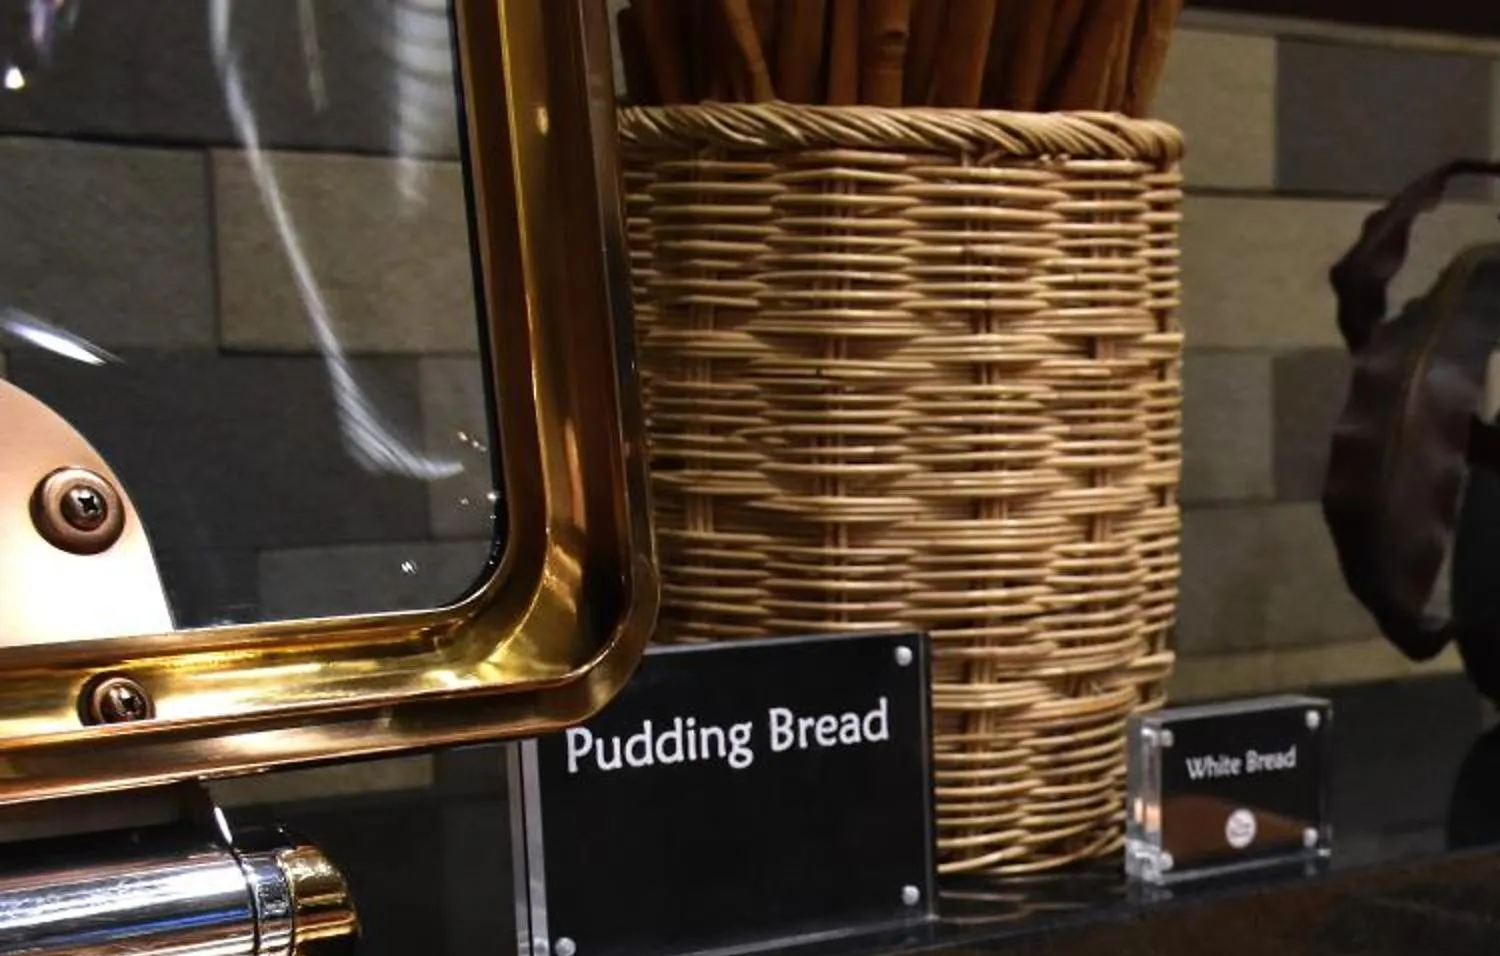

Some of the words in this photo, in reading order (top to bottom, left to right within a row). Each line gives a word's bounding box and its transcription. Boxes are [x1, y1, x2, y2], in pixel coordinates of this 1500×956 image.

[565, 716, 754, 774] Pudding
[768, 696, 889, 752] Bread
[1185, 753, 1242, 781] White
[1245, 743, 1297, 774] Bread
